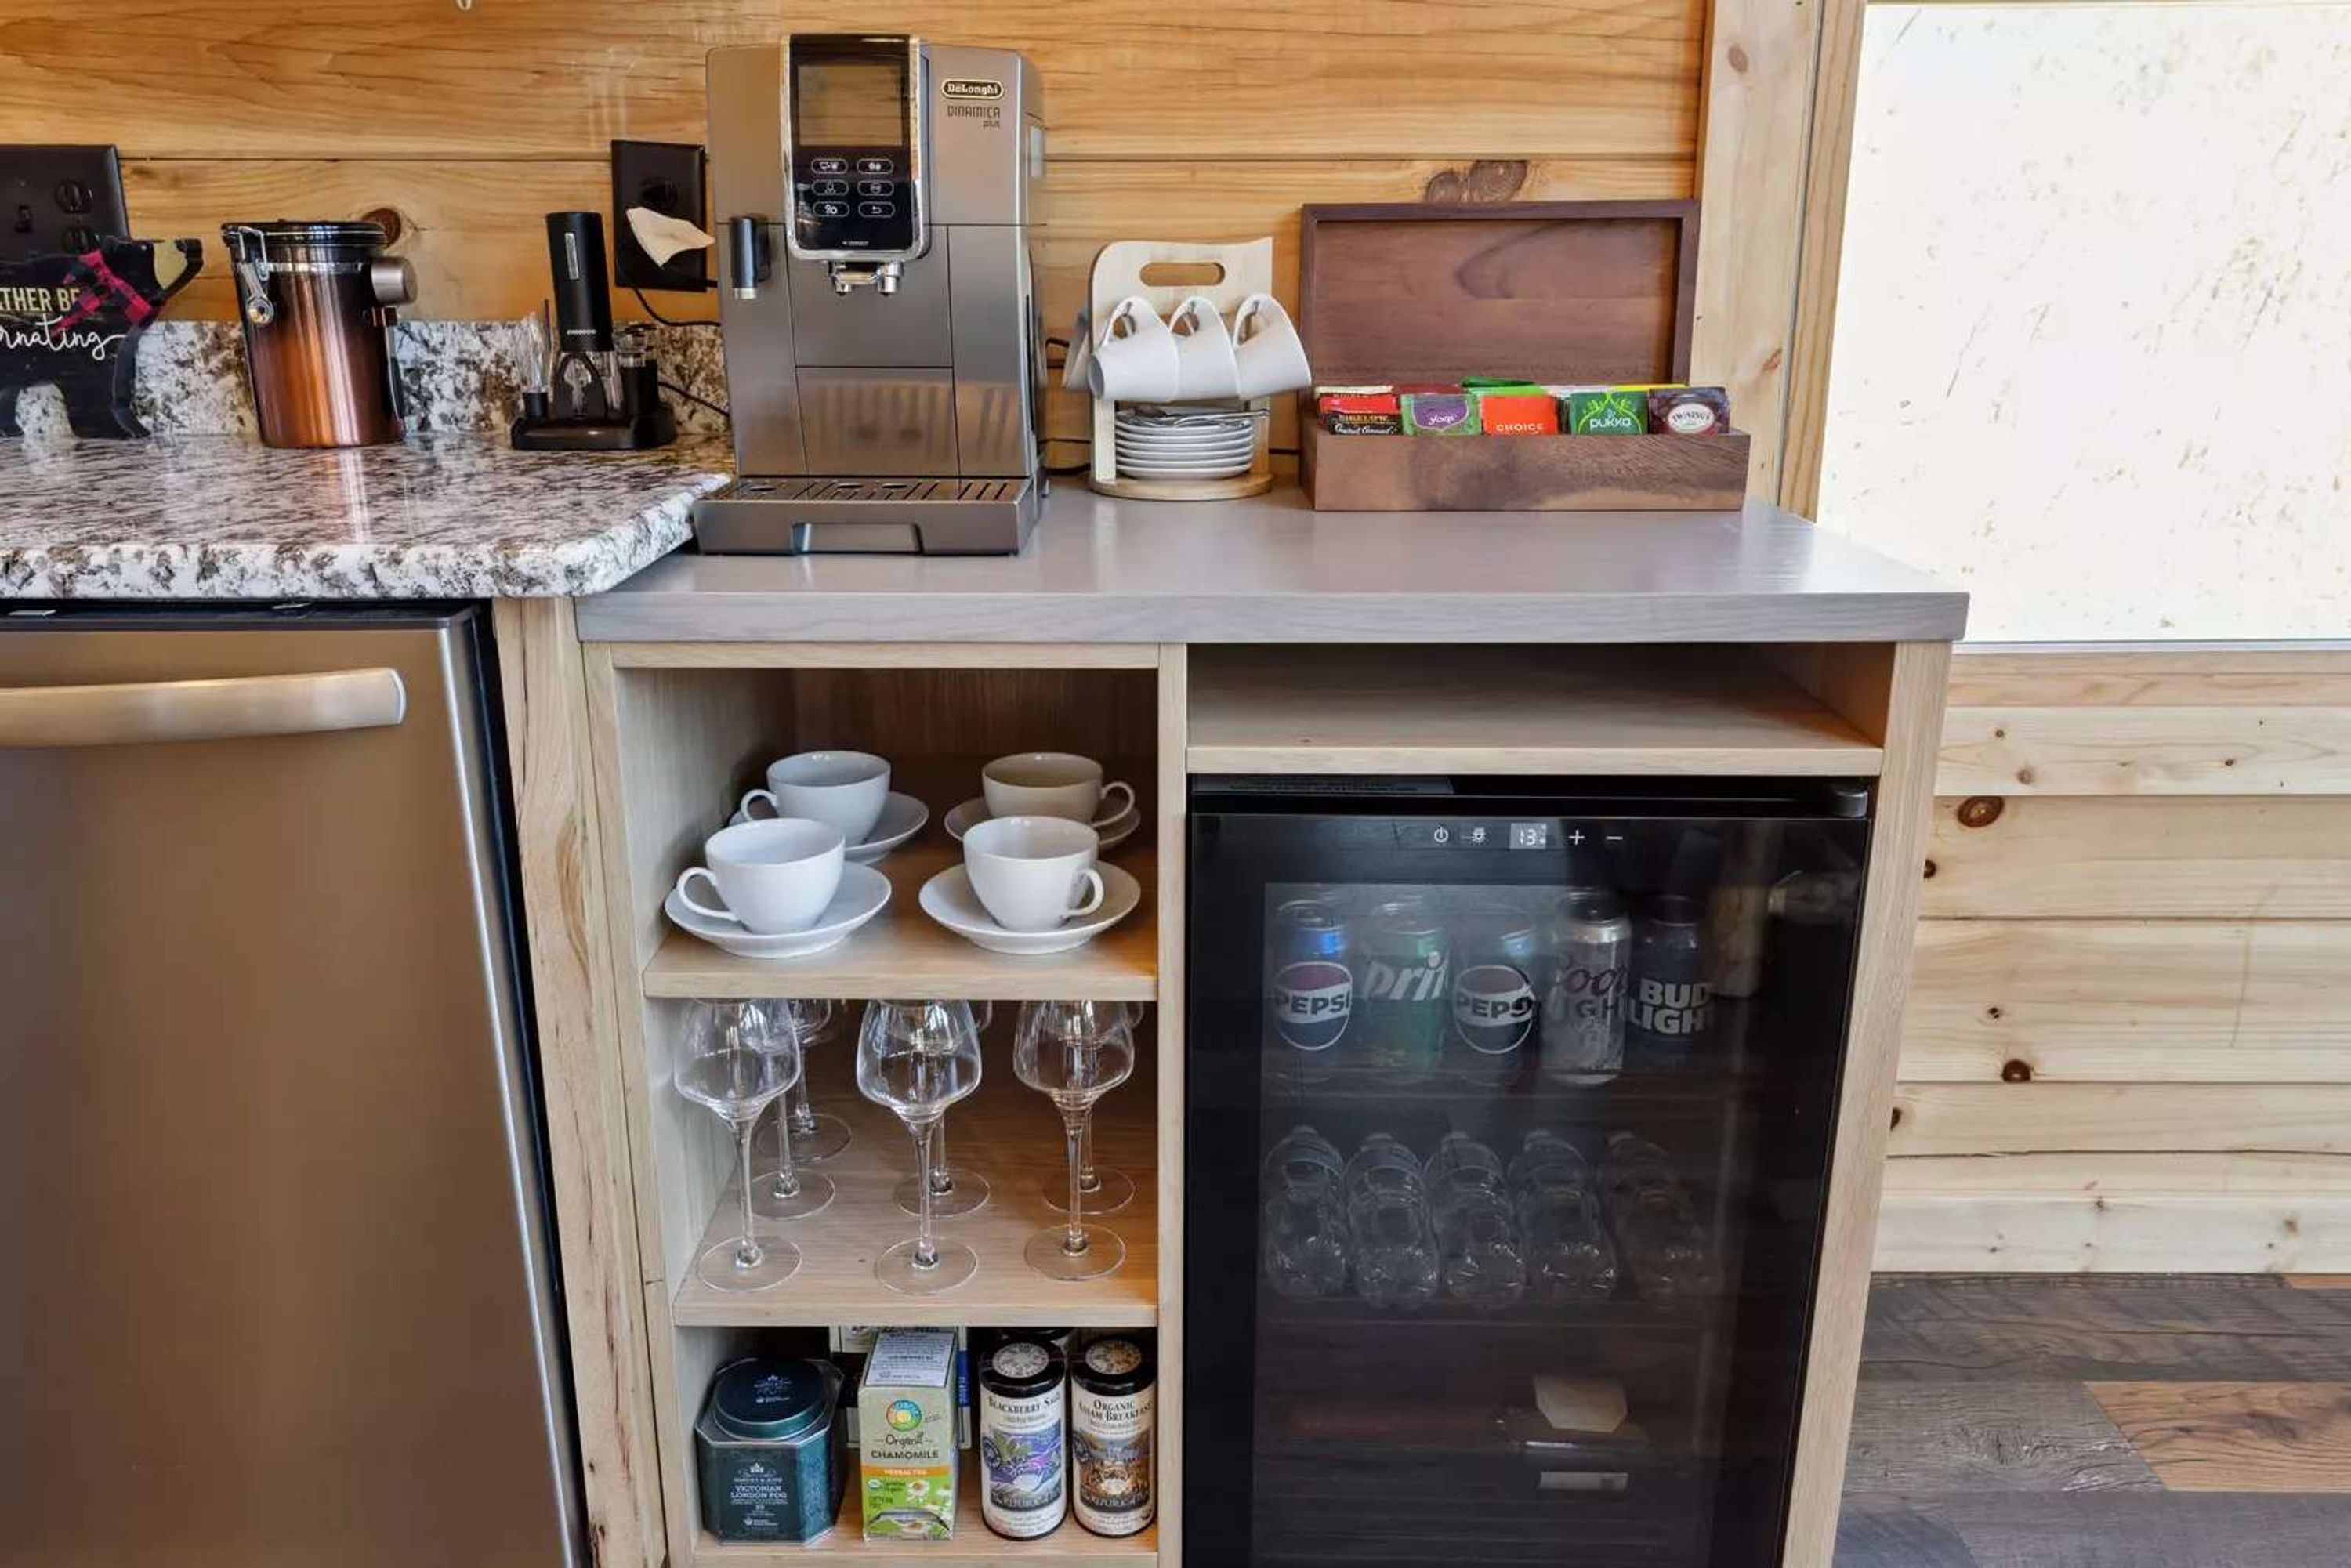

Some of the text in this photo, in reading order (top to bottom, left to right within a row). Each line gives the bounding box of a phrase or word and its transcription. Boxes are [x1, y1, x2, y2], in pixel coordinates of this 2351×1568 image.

[0, 287, 53, 312] THER
[1589, 417, 1632, 431] pukka
[1092, 1399, 1136, 1411] ORGANIC
[871, 1450, 940, 1460] CHAMOMILE
